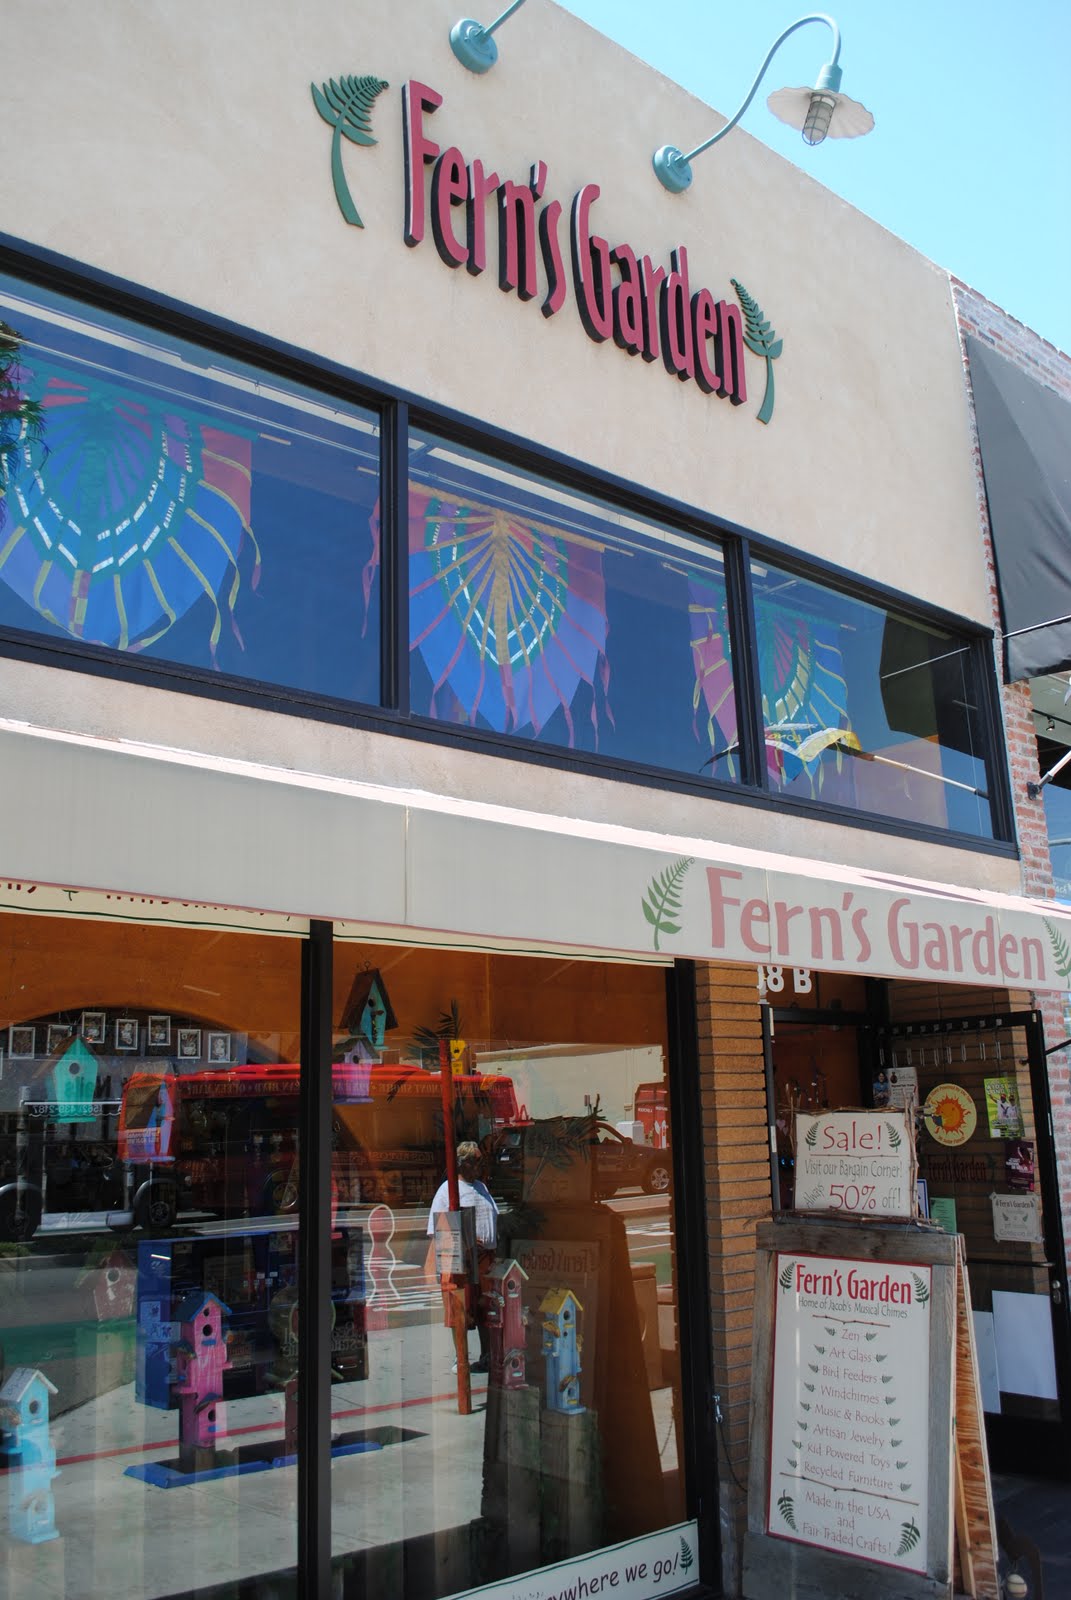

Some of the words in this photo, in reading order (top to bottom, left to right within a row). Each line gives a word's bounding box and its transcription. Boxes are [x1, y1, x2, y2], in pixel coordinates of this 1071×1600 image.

[401, 80, 567, 318] Fern's
[571, 184, 747, 405] Garden
[706, 866, 871, 962] Fern's
[887, 898, 1046, 981] Garden
[793, 968, 812, 993] B
[823, 1121, 881, 1151] Sale!
[804, 1160, 821, 1175] Visit
[823, 1163, 837, 1175] our
[838, 1160, 868, 1182] Bargain
[870, 1160, 903, 1178] Corner!
[804, 1182, 825, 1209] Always
[829, 1185, 876, 1210] 50%
[881, 1187, 901, 1209] off!
[796, 1264, 842, 1297] Fern's
[847, 1269, 912, 1305] Garden
[799, 1298, 819, 1310] Home
[819, 1297, 828, 1309] of
[828, 1297, 852, 1312] Jacob's
[854, 1301, 880, 1316] Musical
[881, 1304, 908, 1319] Chimes
[841, 1329, 860, 1341] Zen
[829, 1348, 845, 1359] Art
[849, 1350, 872, 1362] Glass
[822, 1365, 839, 1377] Bird
[843, 1368, 878, 1383] Feeders
[820, 1385, 880, 1405] Windchimes
[814, 1404, 842, 1417] Music
[844, 1410, 852, 1421] &
[855, 1411, 885, 1425] Books
[812, 1424, 846, 1440] Artisan
[850, 1430, 885, 1448] Jewelry
[807, 1443, 822, 1456] Kid
[825, 1446, 864, 1465] Powered
[869, 1454, 891, 1470] Toys
[804, 1461, 843, 1480] Recycled
[848, 1471, 893, 1490] Furniture
[805, 1491, 830, 1508] Made
[834, 1500, 844, 1510] in
[847, 1500, 863, 1515] the
[867, 1505, 891, 1520] USA
[837, 1516, 855, 1530] and
[856, 1535, 892, 1556] Crafts!
[625, 1563, 648, 1583] we
[653, 1552, 679, 1583] go!
